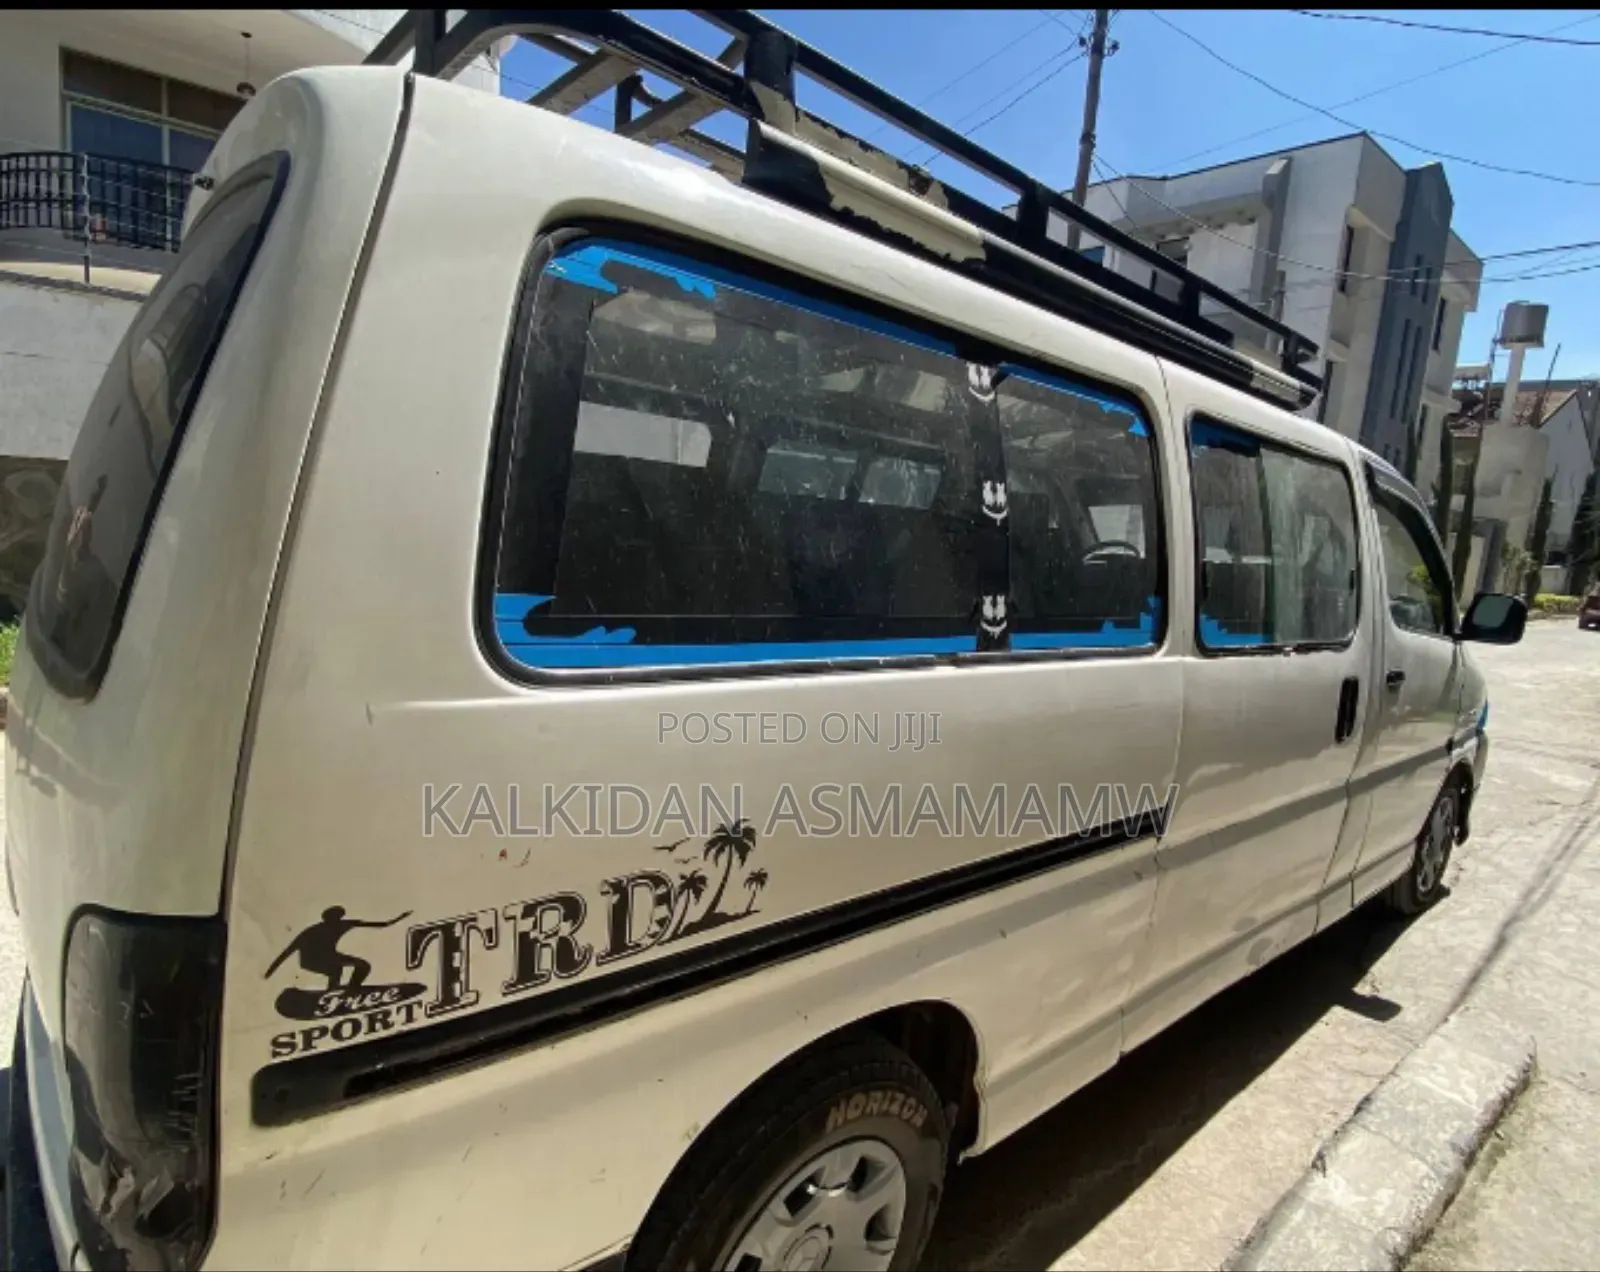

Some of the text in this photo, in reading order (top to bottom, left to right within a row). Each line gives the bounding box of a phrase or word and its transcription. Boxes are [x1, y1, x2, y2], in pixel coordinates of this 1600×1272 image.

[406, 868, 678, 1018] TRD
[270, 999, 424, 1059] SPORT
[825, 1090, 930, 1131] HORIZON
